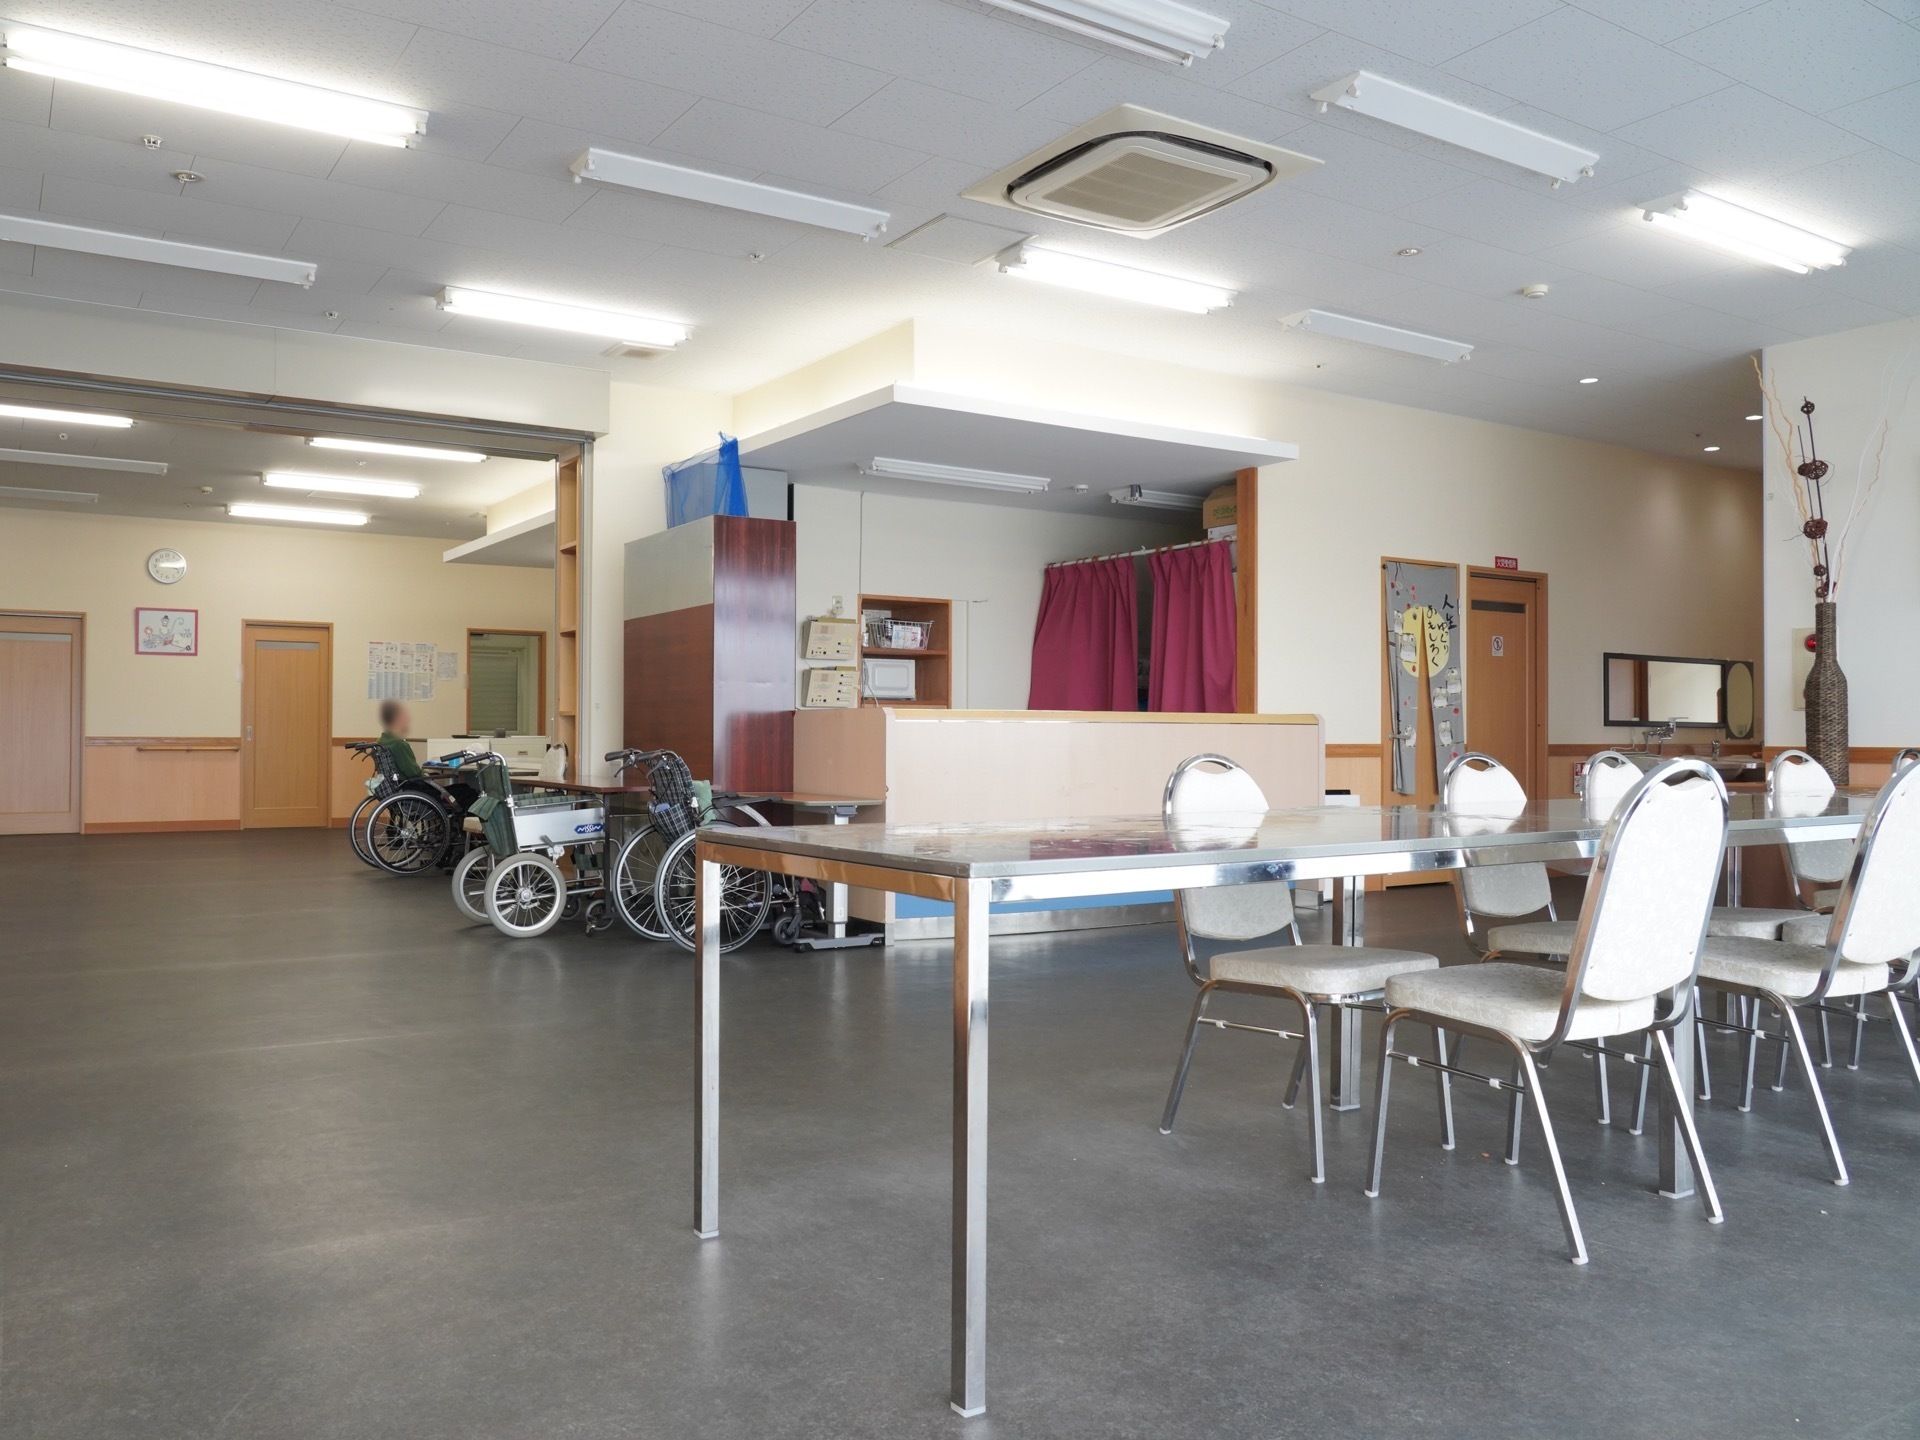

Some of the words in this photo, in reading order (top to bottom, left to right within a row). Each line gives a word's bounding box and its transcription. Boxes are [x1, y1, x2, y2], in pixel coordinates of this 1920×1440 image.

[1426, 604, 1440, 667] おもしろく
[1442, 593, 1457, 630] 人生
